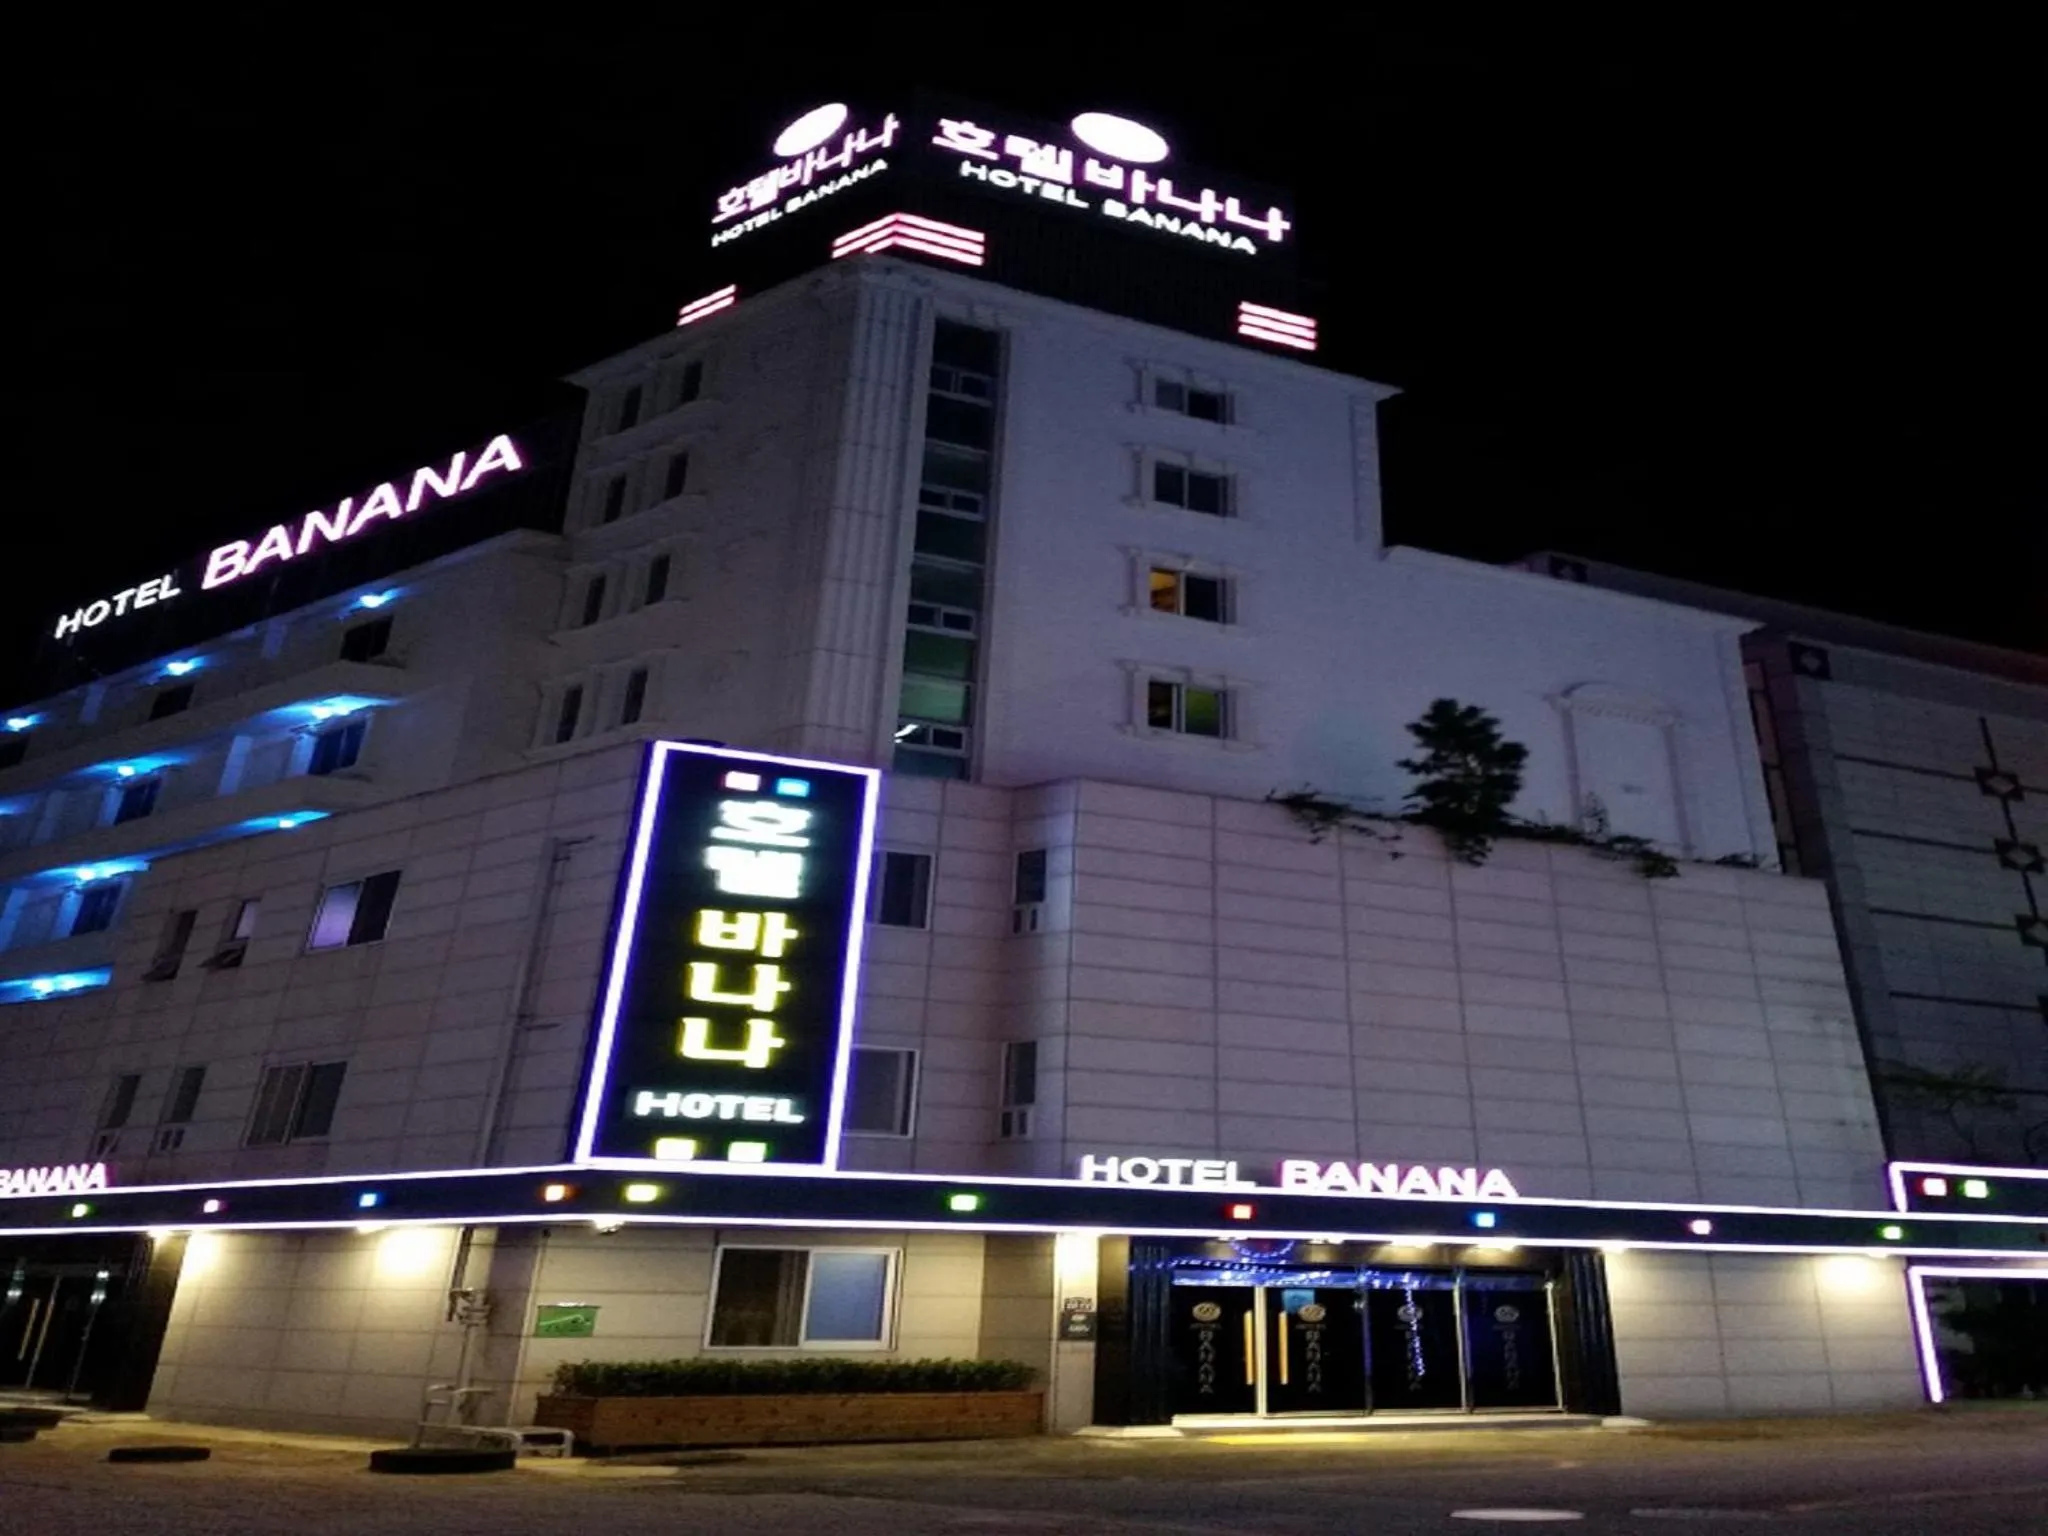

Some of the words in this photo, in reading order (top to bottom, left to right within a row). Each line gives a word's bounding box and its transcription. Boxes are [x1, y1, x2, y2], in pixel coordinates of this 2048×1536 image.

[711, 208, 783, 247] HOTEL
[785, 158, 888, 213] BANANA
[960, 160, 1089, 209] HOTEL
[1103, 198, 1257, 255] BANANA
[54, 574, 181, 639] HOTEL
[201, 434, 522, 590] BANANA
[634, 1090, 805, 1124] HOTEL
[1080, 1155, 1256, 1188] HOTEL
[1281, 1159, 1519, 1198] BANANA
